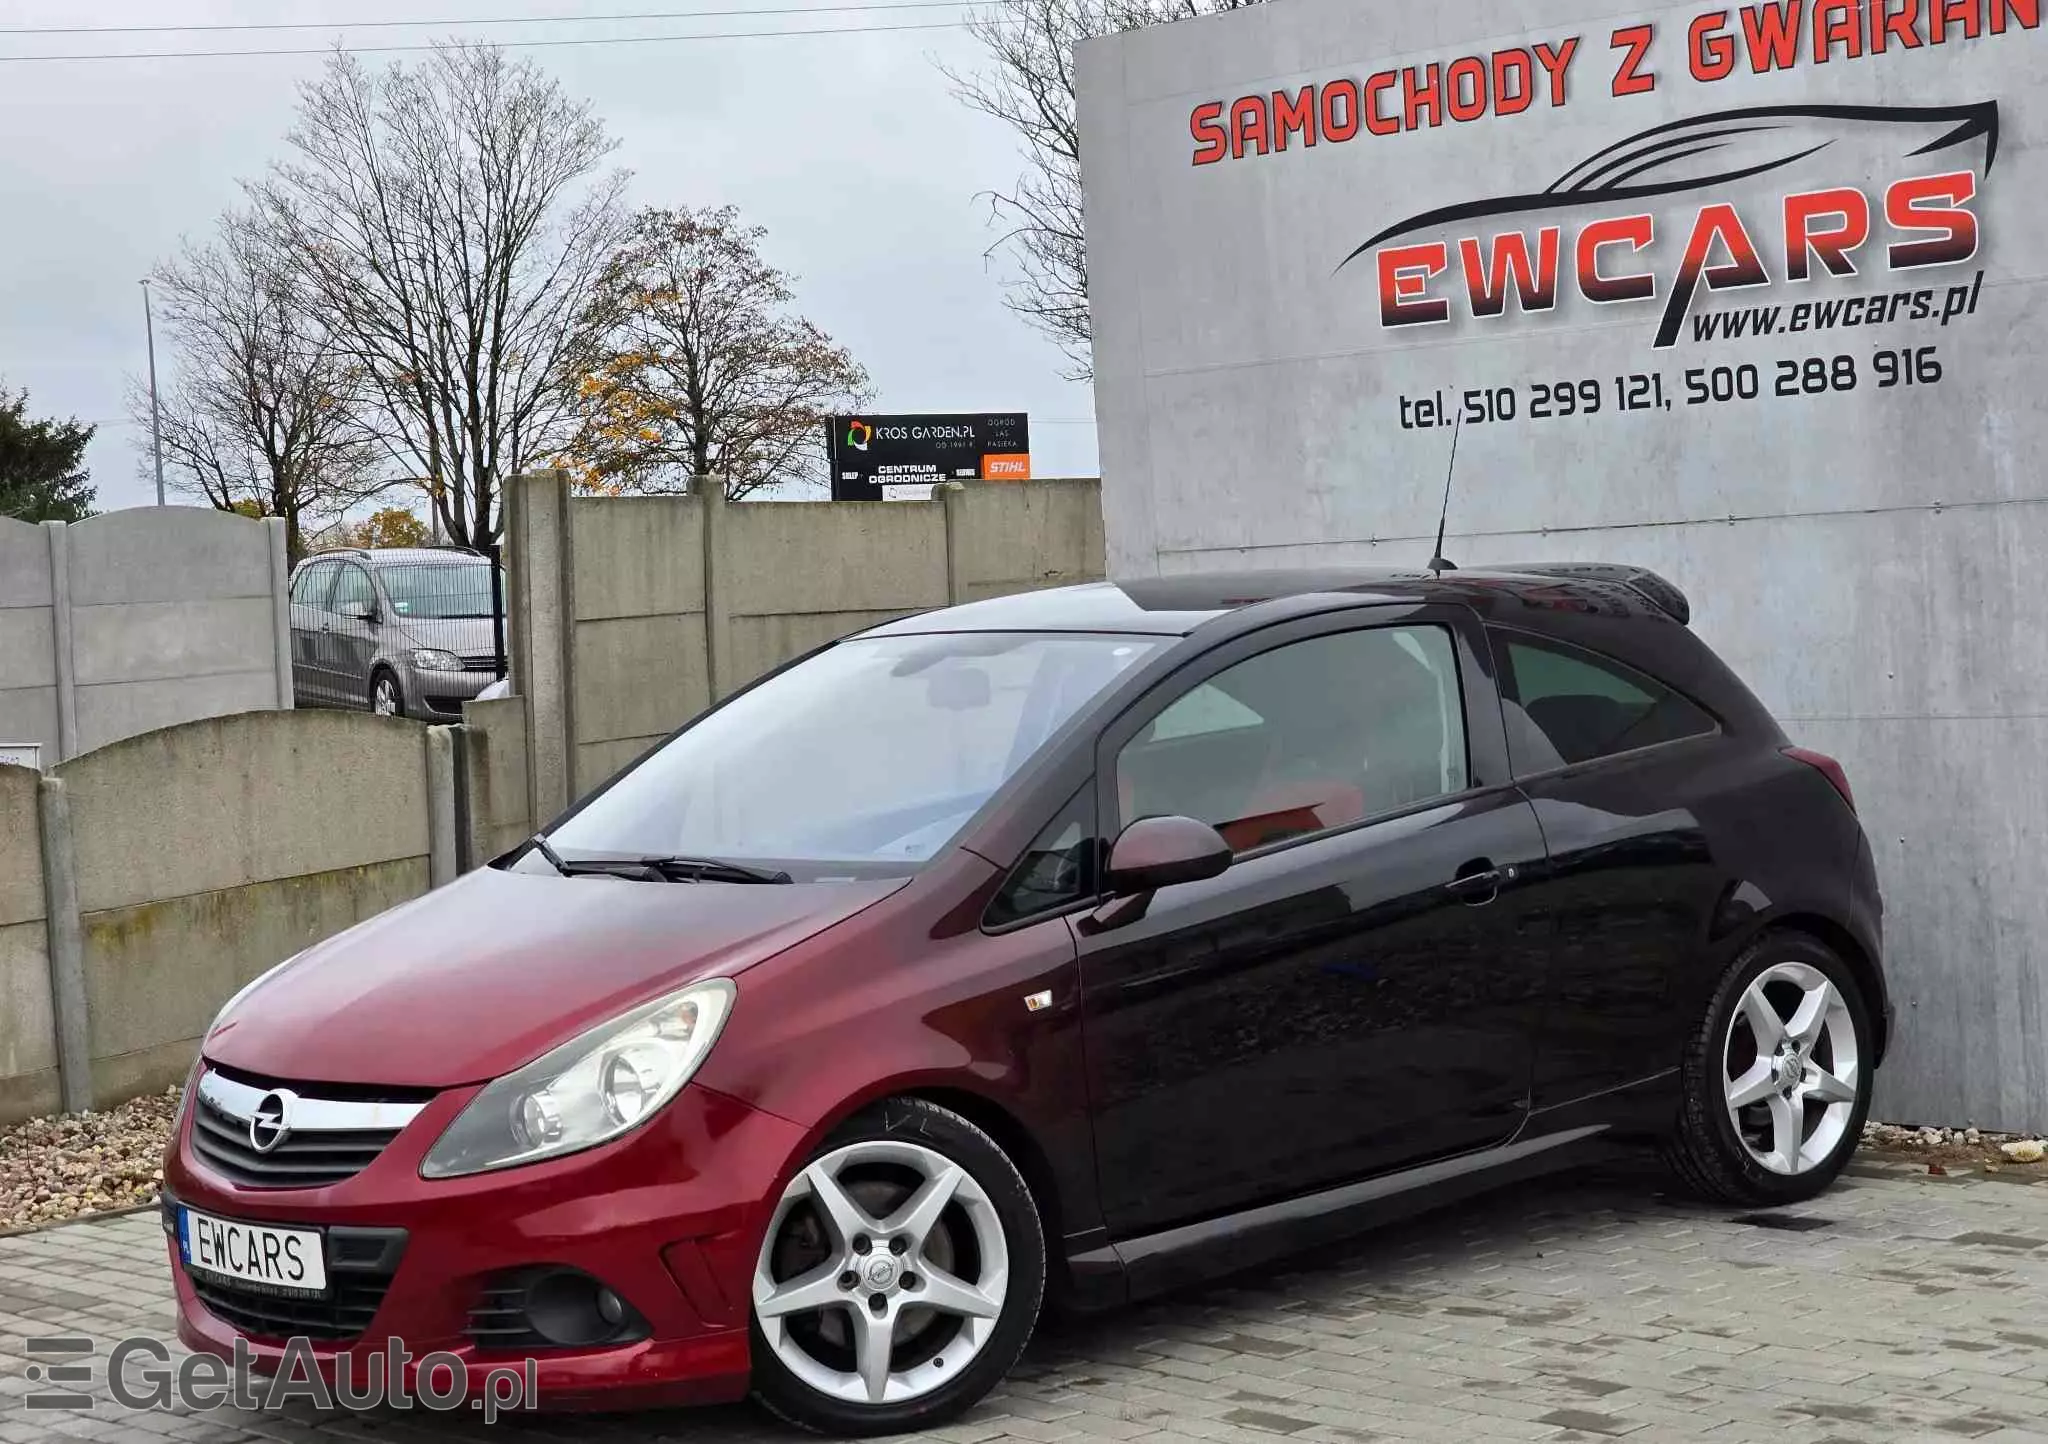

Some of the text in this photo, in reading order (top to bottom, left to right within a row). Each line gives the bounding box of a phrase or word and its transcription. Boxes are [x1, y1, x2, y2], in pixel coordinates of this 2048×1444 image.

[1190, 38, 1578, 166] SAMOCHODY
[1609, 24, 1655, 97] Z
[1376, 170, 1980, 350] EWCARS
[1692, 271, 1985, 343] www.ewcars.pl
[1400, 346, 1943, 429] tel. 510 299 121, 500 288 916
[876, 425, 976, 440] KROS GARDEN.PL
[868, 473, 947, 484] OGRODNICZE
[878, 464, 937, 474] CENTRUM
[990, 461, 1026, 473] STIHL
[197, 1216, 305, 1281] EWCARS
